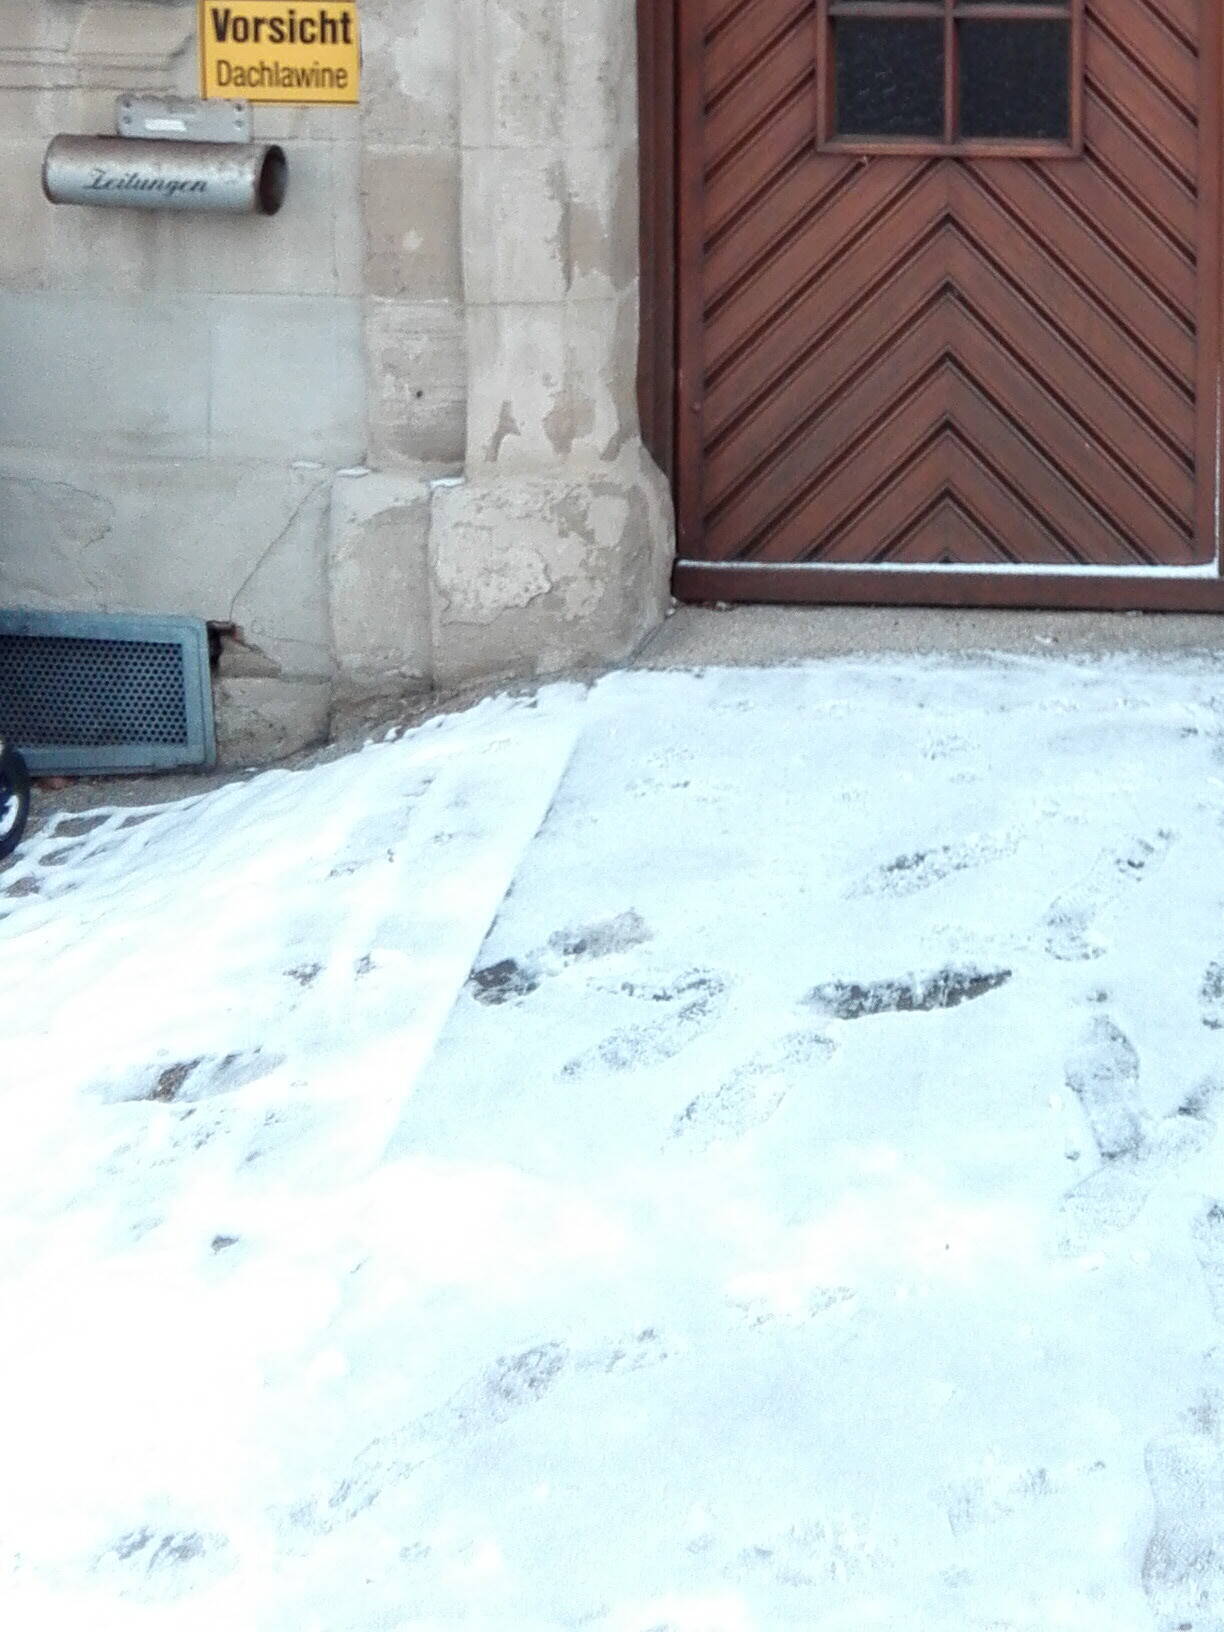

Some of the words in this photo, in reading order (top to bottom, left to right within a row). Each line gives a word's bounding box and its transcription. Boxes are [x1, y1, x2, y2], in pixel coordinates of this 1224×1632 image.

[211, 7, 352, 44] Vorsicht
[216, 59, 348, 88] Dachlawine
[83, 168, 208, 196] Zeitungen
